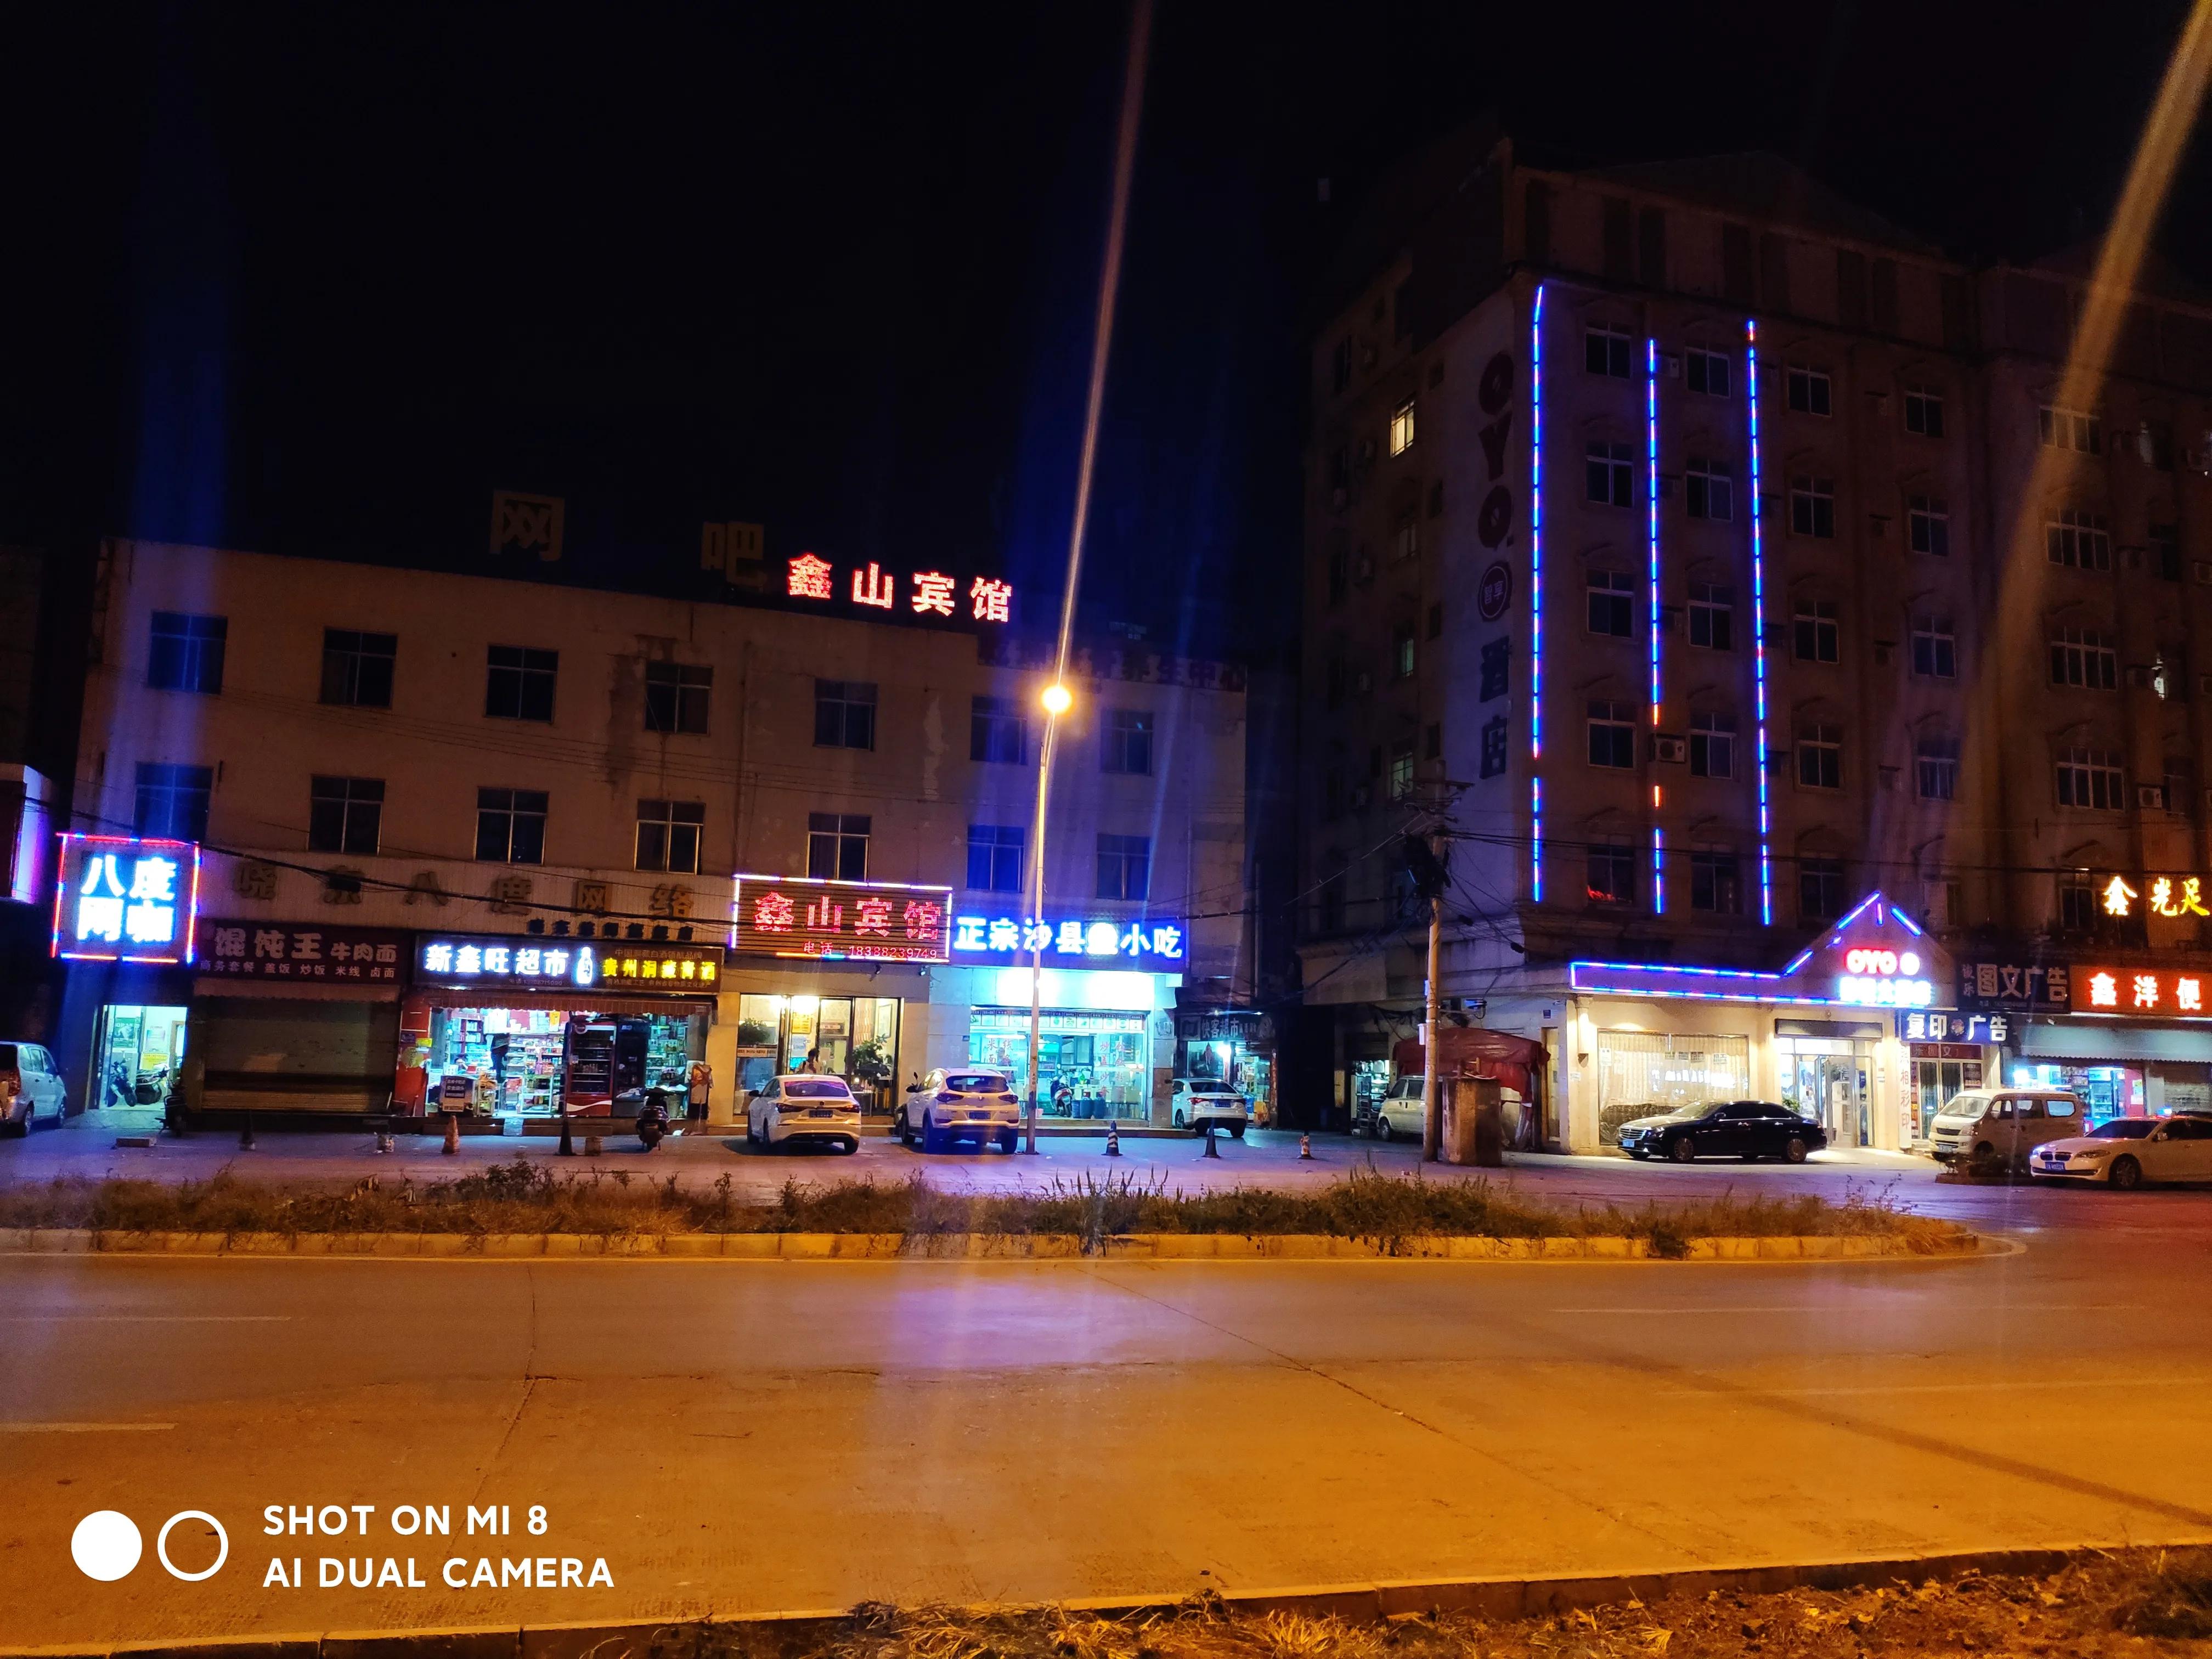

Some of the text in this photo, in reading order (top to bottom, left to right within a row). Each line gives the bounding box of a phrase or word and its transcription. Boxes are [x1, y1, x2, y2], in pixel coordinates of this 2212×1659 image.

[788, 554, 1012, 623] 鑫山宾馆
[80, 854, 177, 901] 八度
[754, 891, 941, 940] 鑫山宾馆
[330, 941, 398, 963] 牛肉面
[425, 944, 569, 977] 新鑫旺超市
[300, 963, 326, 975] 炒饭
[335, 966, 360, 978] 米线
[370, 967, 396, 979] 卤面
[1977, 963, 2068, 1002] 图文广告
[1906, 1013, 2008, 1041] 复印 广告
